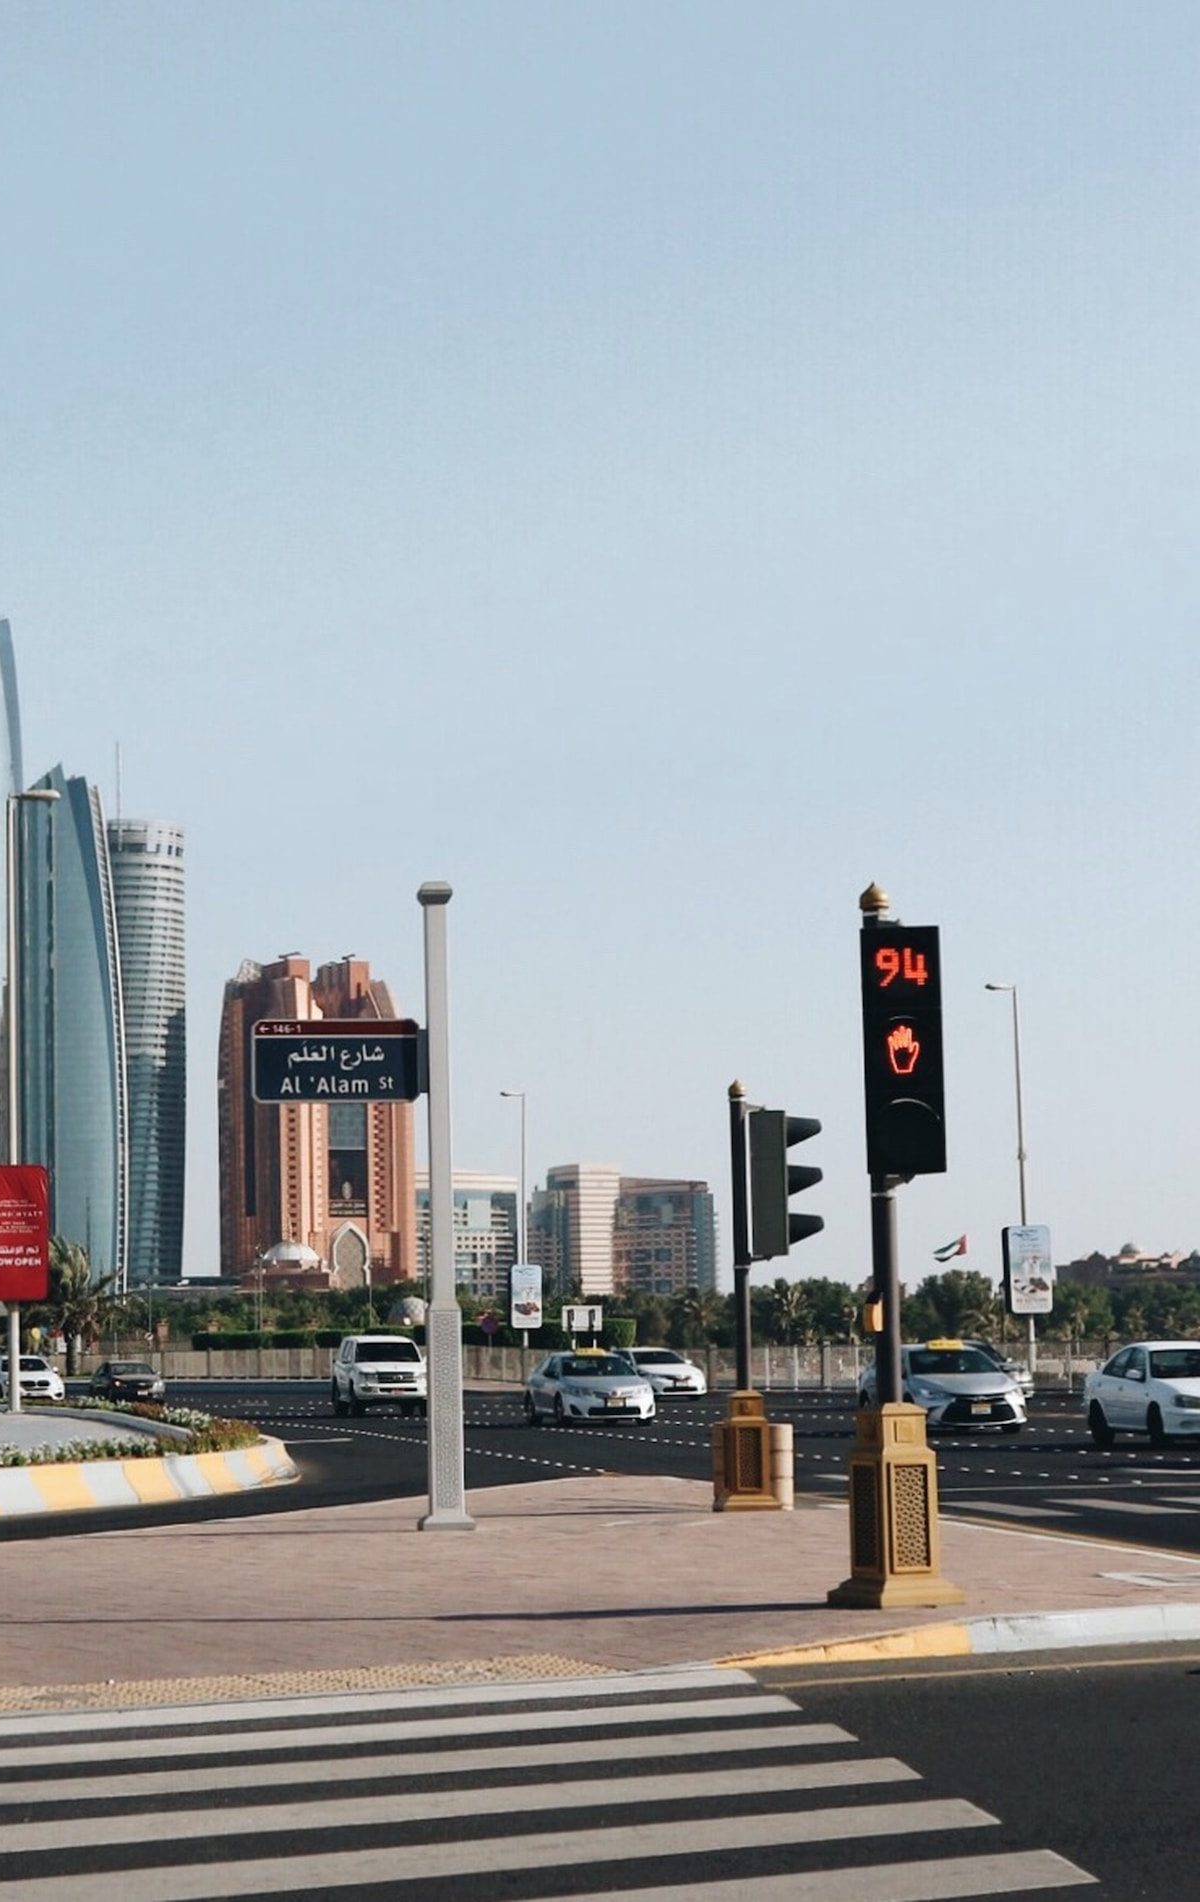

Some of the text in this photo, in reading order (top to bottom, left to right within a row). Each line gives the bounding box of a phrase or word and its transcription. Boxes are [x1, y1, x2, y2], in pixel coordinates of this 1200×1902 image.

[876, 947, 928, 987] 94
[340, 1043, 385, 1071] شارع
[280, 1077, 301, 1094] Al
[378, 1076, 394, 1090] St
[14, 1257, 42, 1266] OPEN
